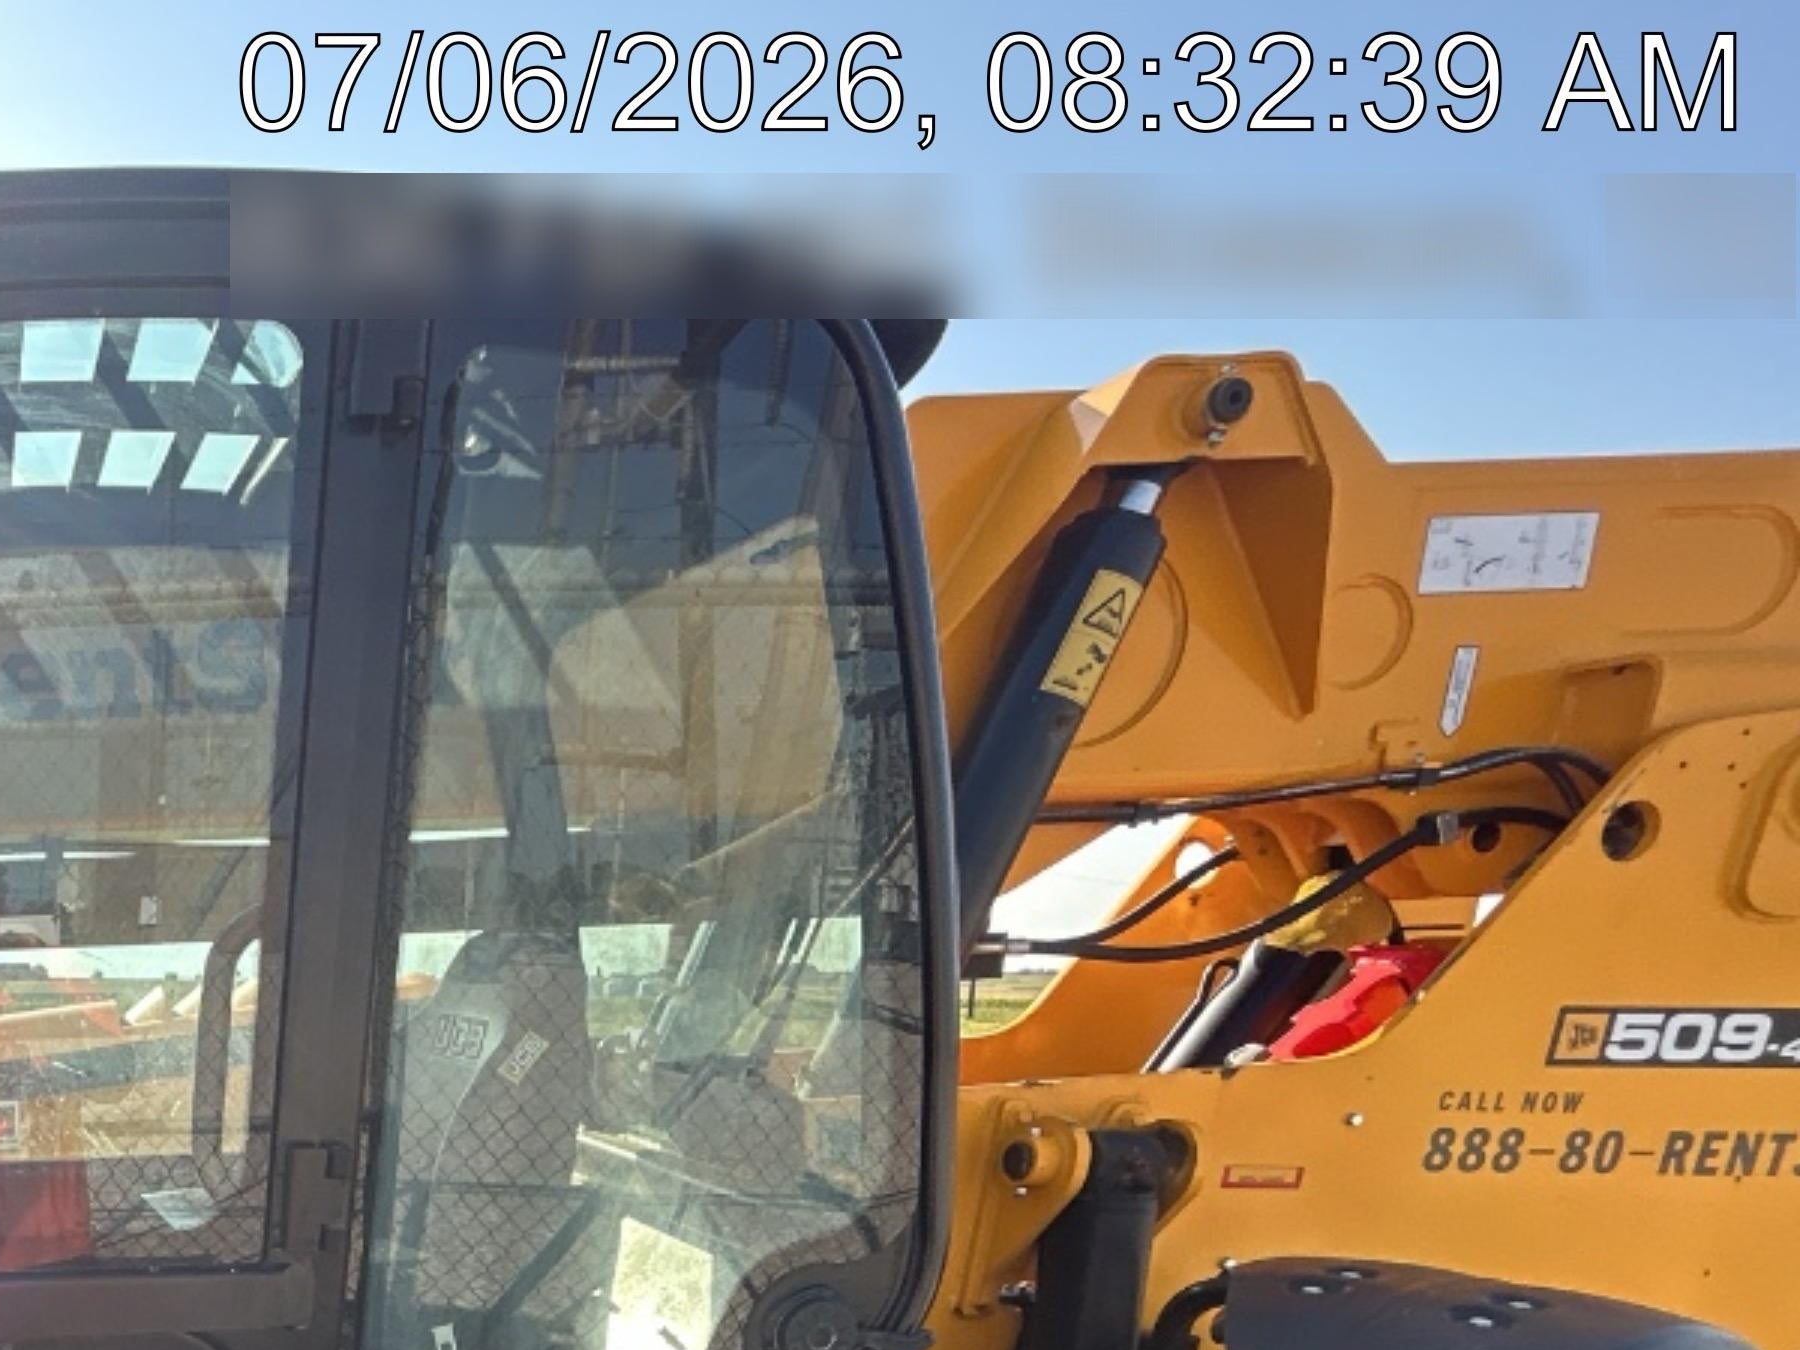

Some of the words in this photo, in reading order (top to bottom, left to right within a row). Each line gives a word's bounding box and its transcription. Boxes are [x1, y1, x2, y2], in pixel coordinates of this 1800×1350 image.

[1438, 1091, 1504, 1112] CALL
[1521, 1091, 1584, 1113] NOW
[1422, 1127, 1800, 1178] 888-80-RENT
